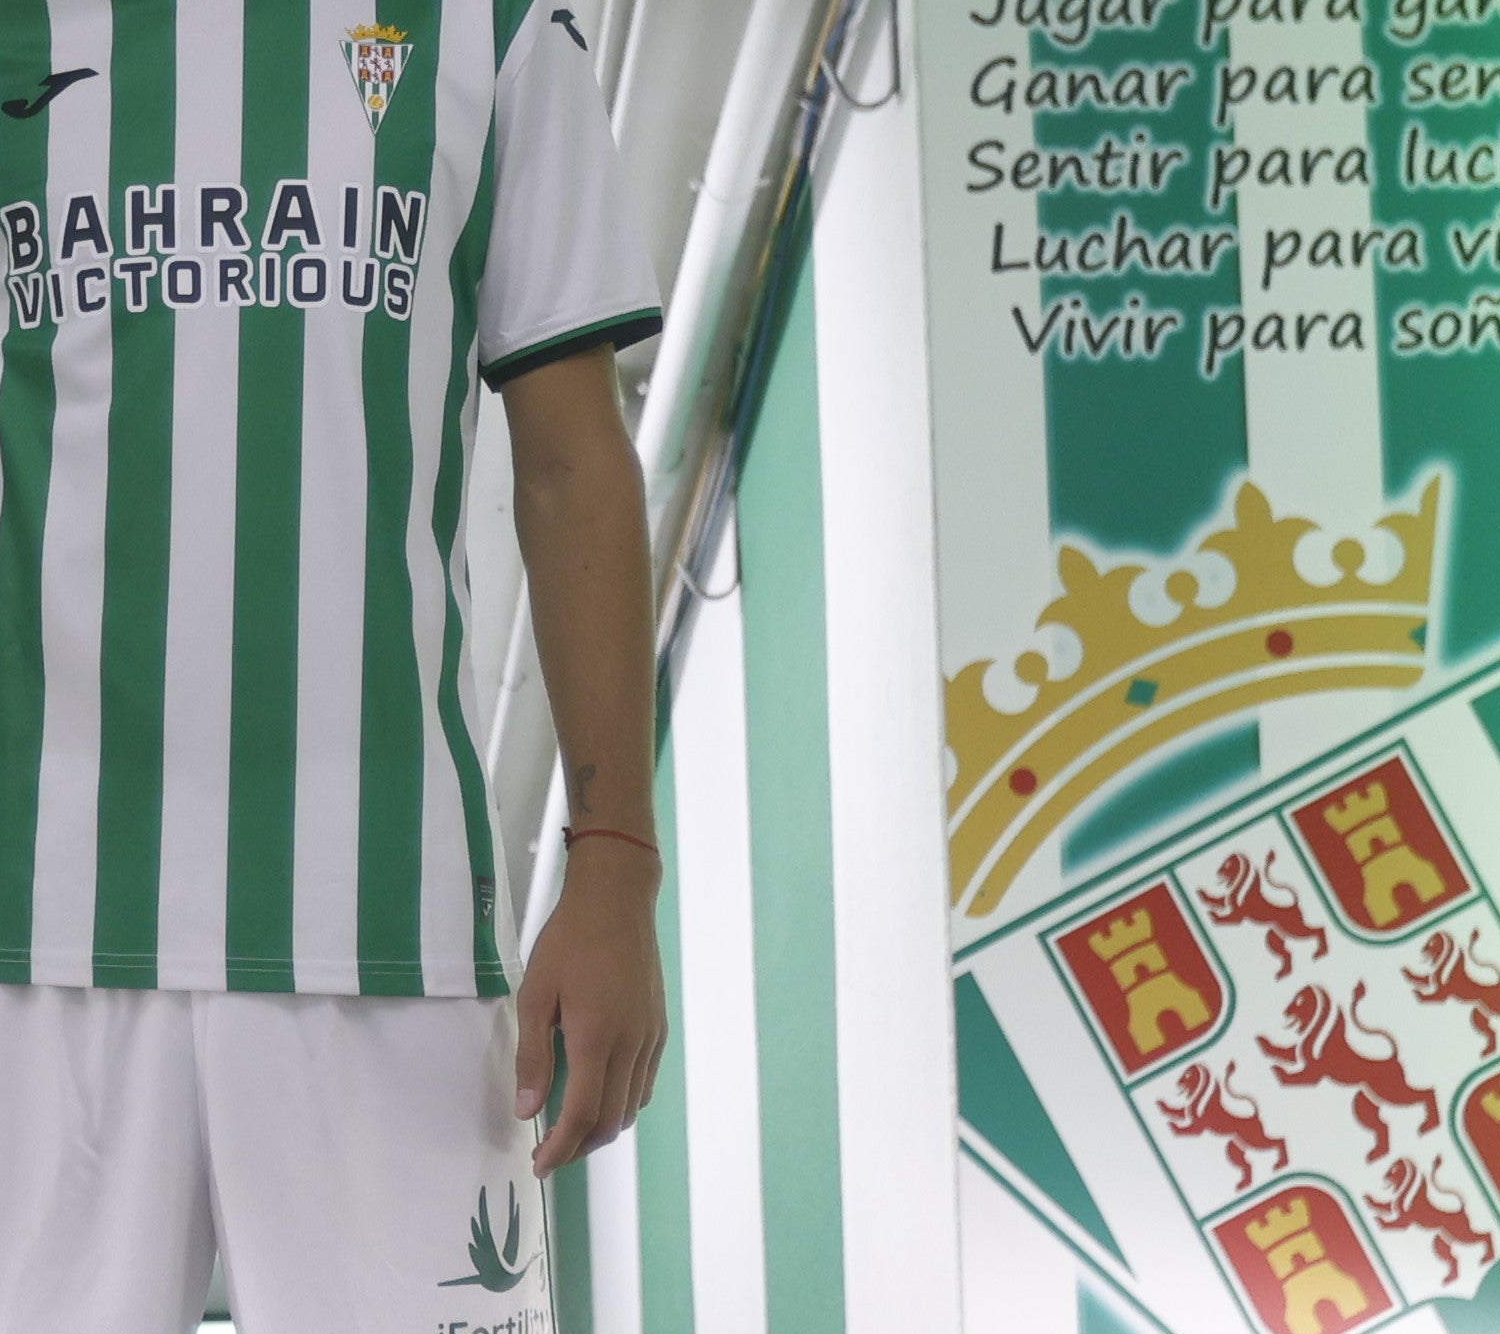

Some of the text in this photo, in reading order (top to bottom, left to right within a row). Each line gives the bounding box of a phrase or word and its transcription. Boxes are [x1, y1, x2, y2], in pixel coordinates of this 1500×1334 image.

[971, 57, 1189, 113] Ganar
[1217, 63, 1376, 126] para
[967, 134, 1184, 193] Sentir
[1211, 144, 1370, 208] para
[3, 182, 425, 271] BAHRAIN
[992, 216, 1234, 273] Luchar
[1264, 225, 1420, 289] para
[10, 256, 414, 326] VICTORIOUS
[1012, 299, 1177, 355] Vivir
[1204, 308, 1364, 375] para
